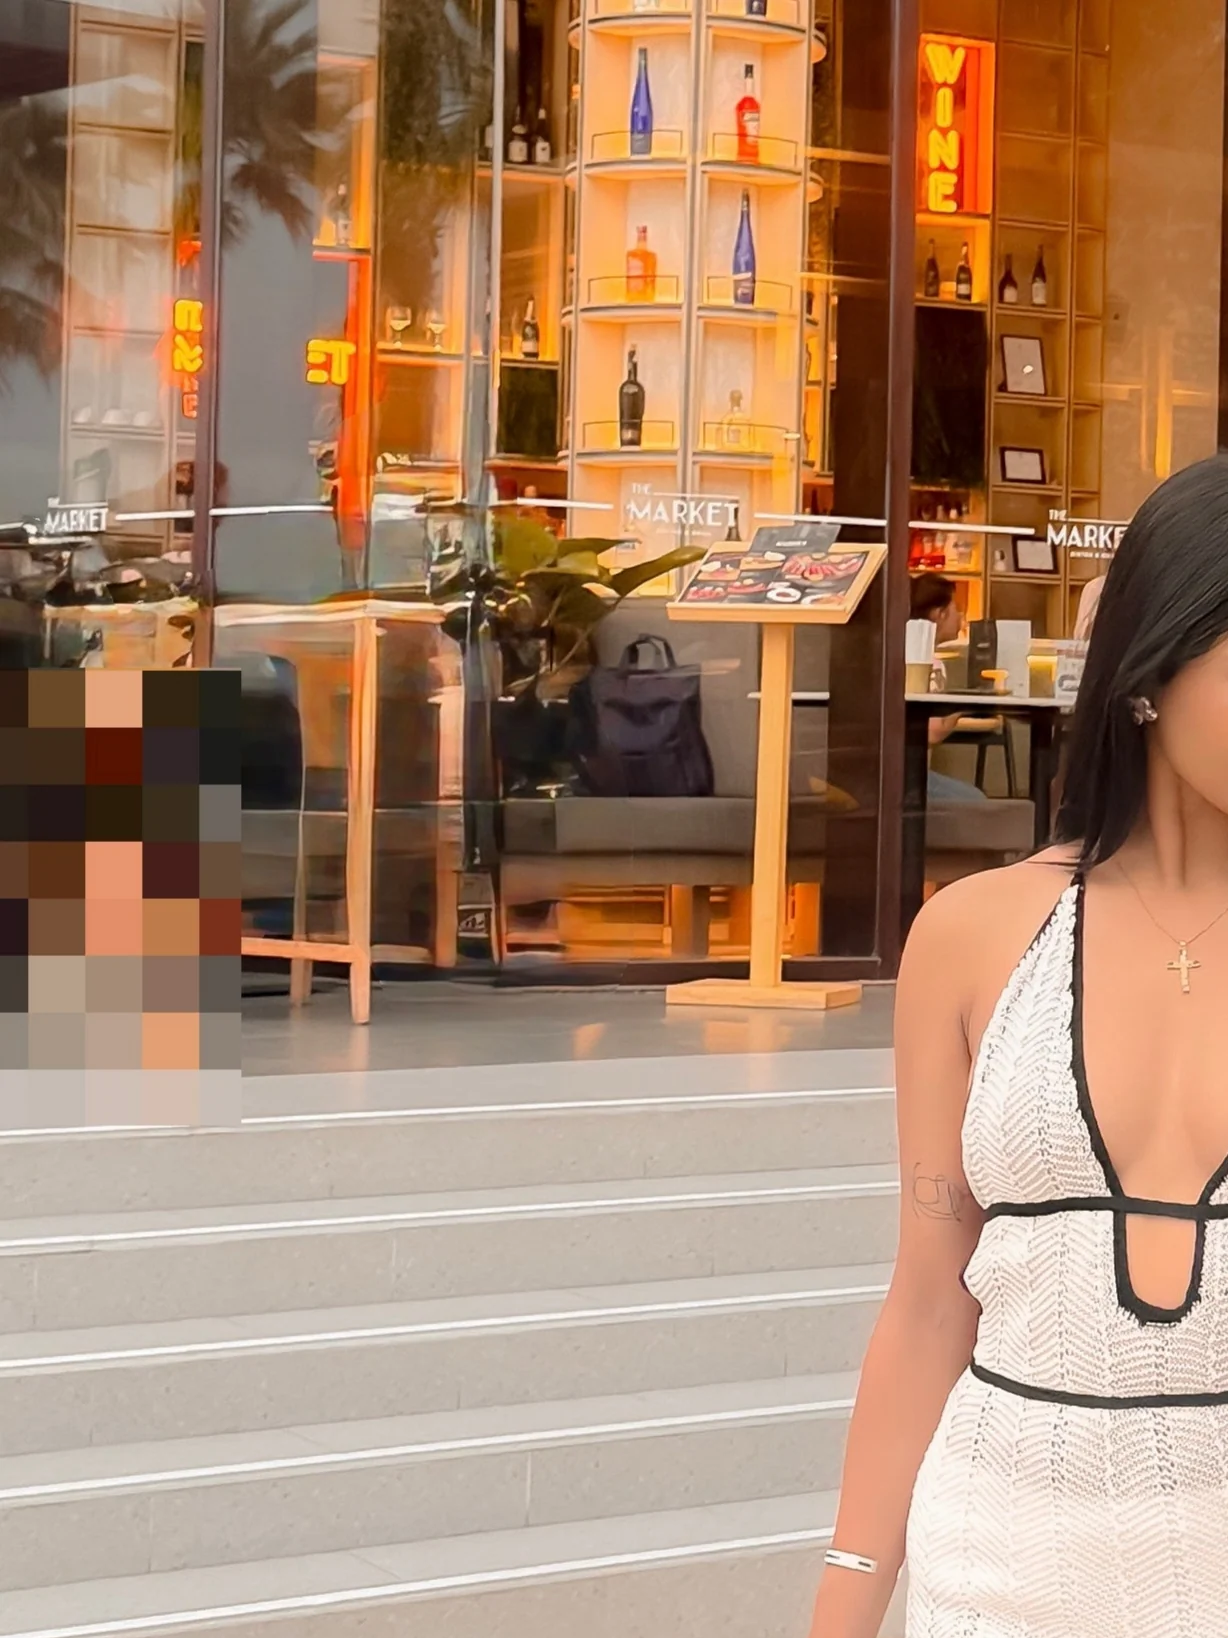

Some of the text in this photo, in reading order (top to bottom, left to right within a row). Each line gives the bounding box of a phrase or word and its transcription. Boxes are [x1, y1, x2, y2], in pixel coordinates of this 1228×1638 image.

[925, 42, 966, 213] WINE
[627, 498, 740, 528] MARKET
[1046, 522, 1129, 550] MARKE
